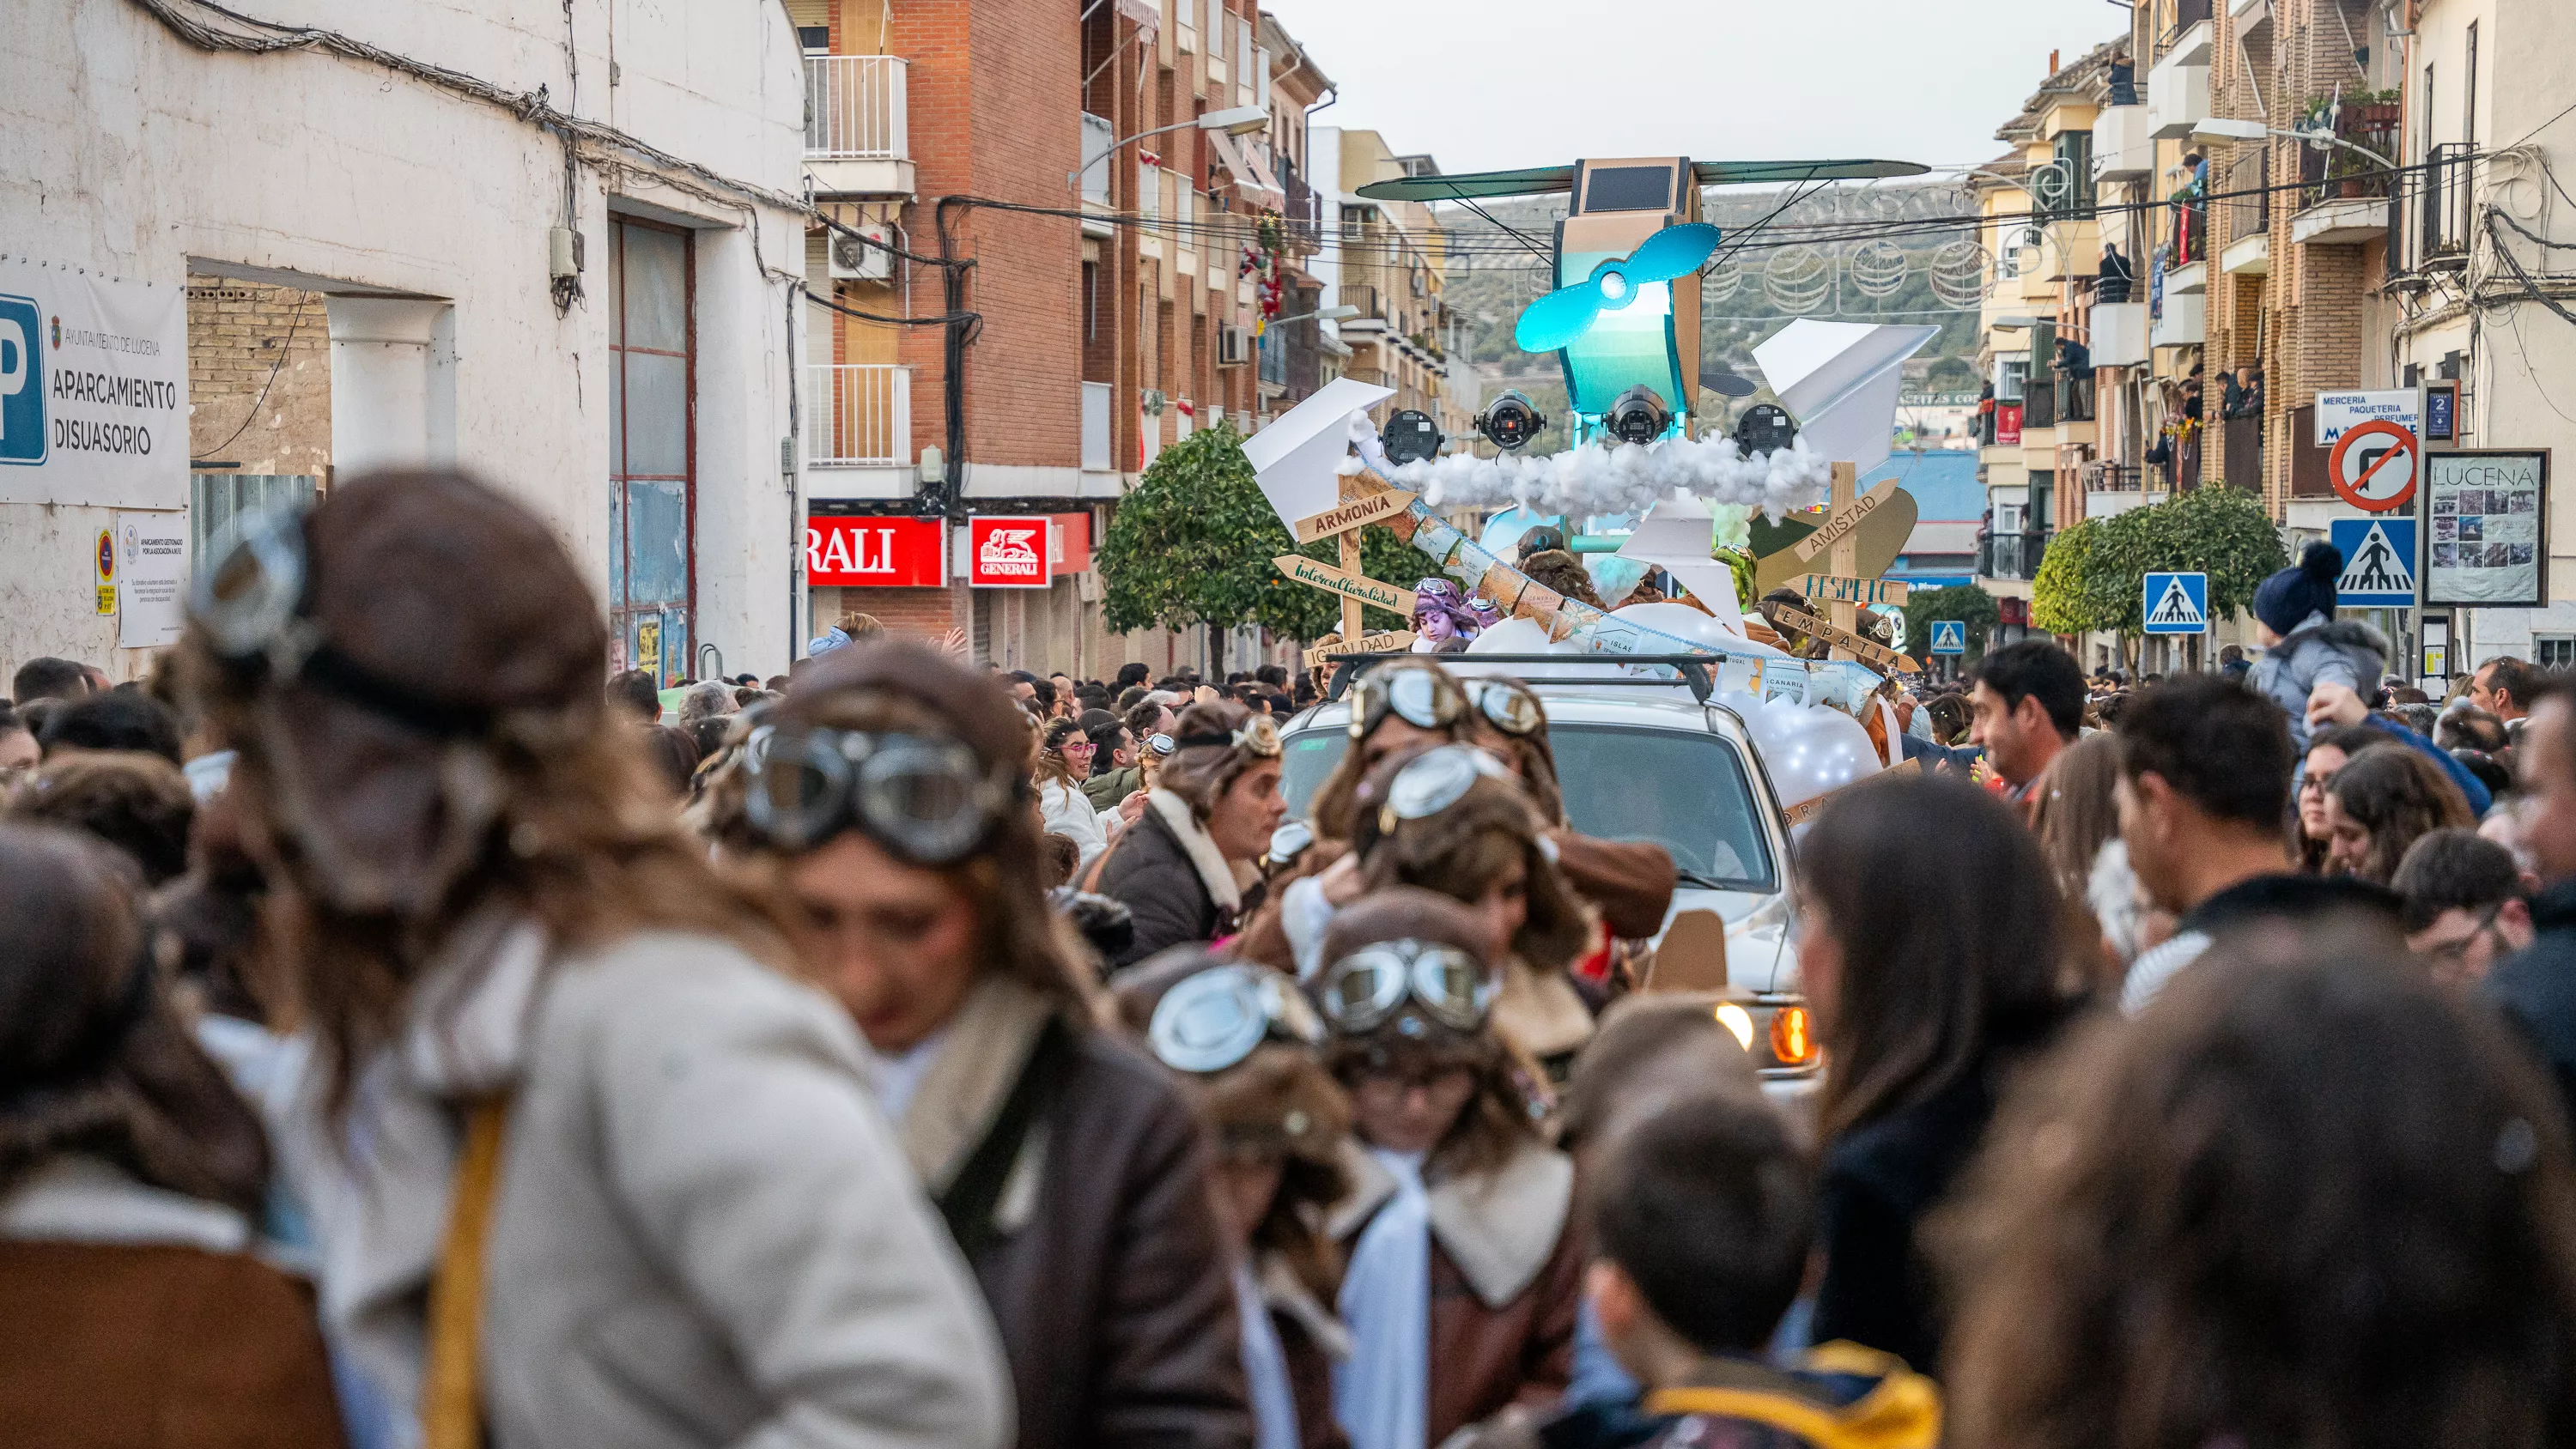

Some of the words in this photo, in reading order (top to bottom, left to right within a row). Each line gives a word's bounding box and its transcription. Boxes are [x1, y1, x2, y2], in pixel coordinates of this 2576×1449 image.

[65, 328, 118, 351] AYUNTAMIENTO
[120, 337, 131, 353] DE
[132, 338, 161, 356] LUCENA
[53, 368, 175, 410] APARCAMIENTO
[2323, 396, 2366, 405] MERCERIA
[2349, 404, 2401, 414] PAQUETERIA
[2435, 398, 2445, 410] 2
[55, 418, 151, 455] DISUASORIO
[2433, 467, 2535, 486] LUCENA
[1315, 496, 1391, 533] ARMONÍA
[1809, 495, 1875, 552] AMISTAD
[980, 563, 1038, 575] GENERALI
[1806, 574, 1893, 603] RESPETO
